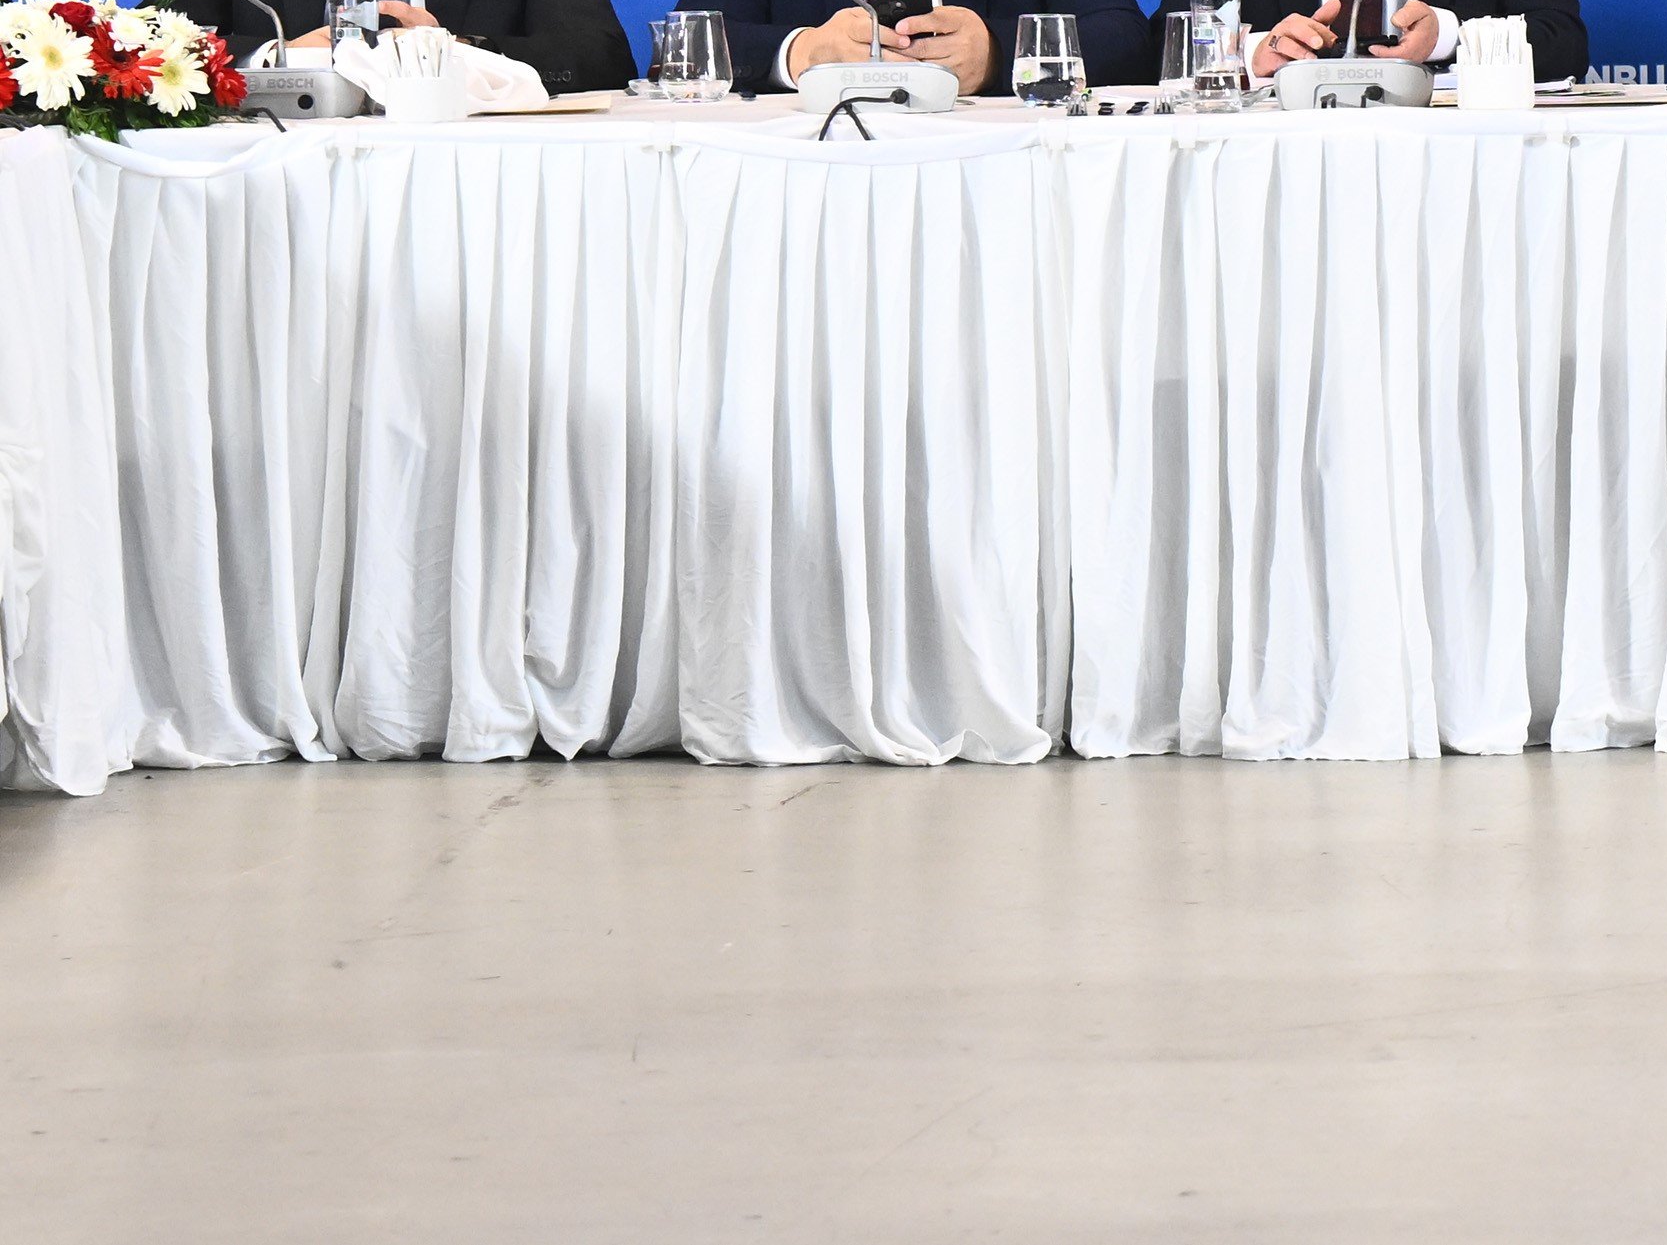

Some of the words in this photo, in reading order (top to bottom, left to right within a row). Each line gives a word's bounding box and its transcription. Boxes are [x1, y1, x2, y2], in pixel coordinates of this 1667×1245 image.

[863, 72, 909, 83] BOSCH
[1337, 68, 1384, 79] BOSCH
[266, 78, 314, 89] BOSCH
